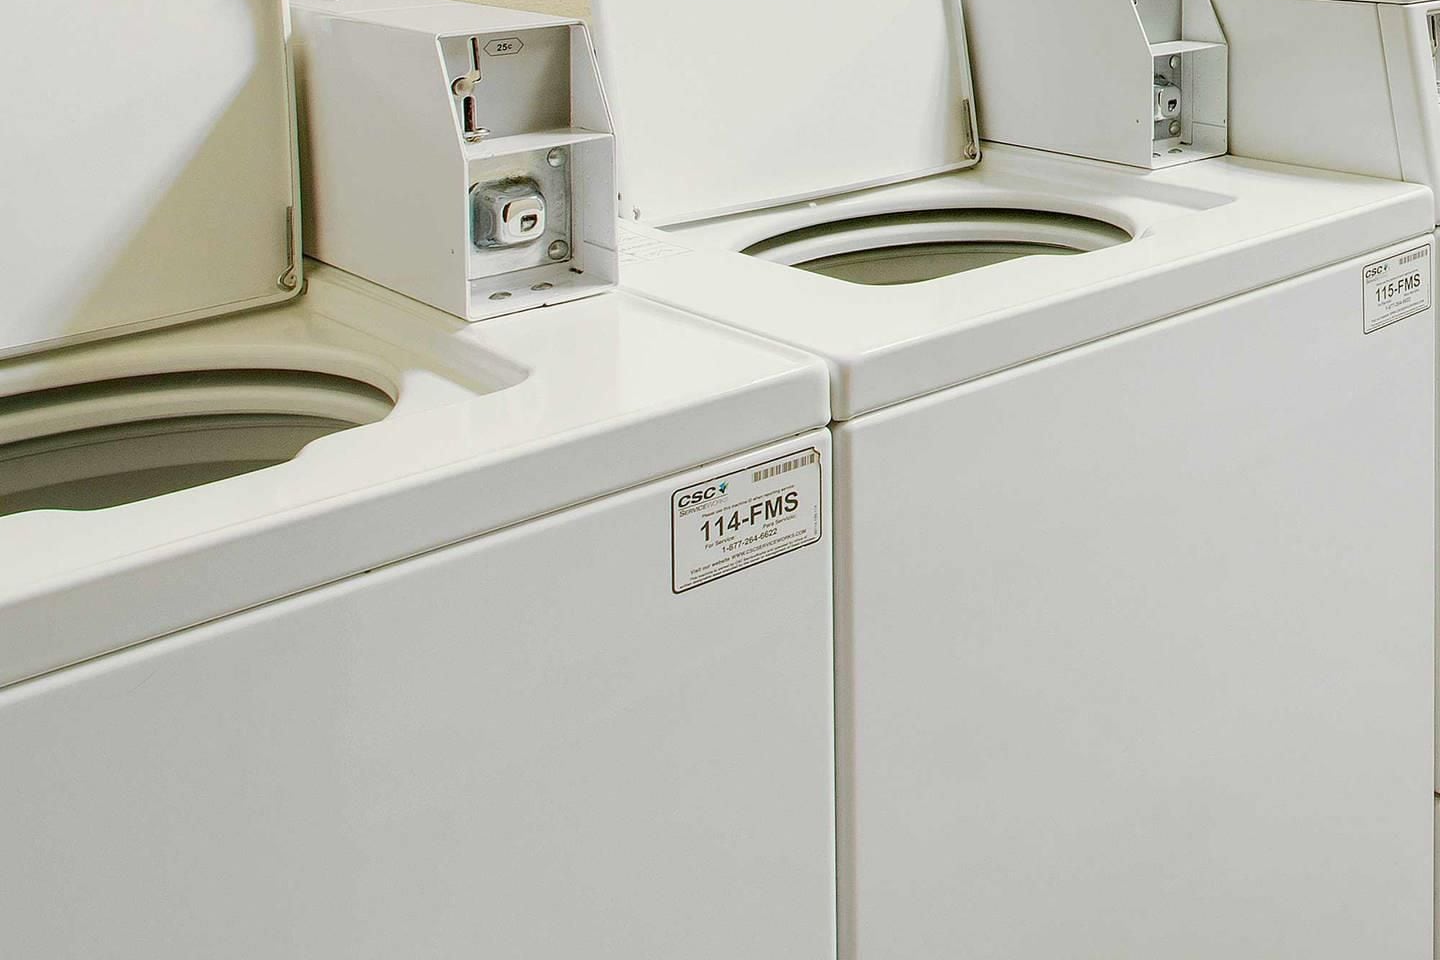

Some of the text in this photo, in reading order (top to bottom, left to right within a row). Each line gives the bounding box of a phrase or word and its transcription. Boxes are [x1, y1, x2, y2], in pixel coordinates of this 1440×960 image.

[1376, 273, 1421, 302] 115-FMS
[678, 486, 716, 508] CSC
[700, 491, 799, 542] 114-FMS
